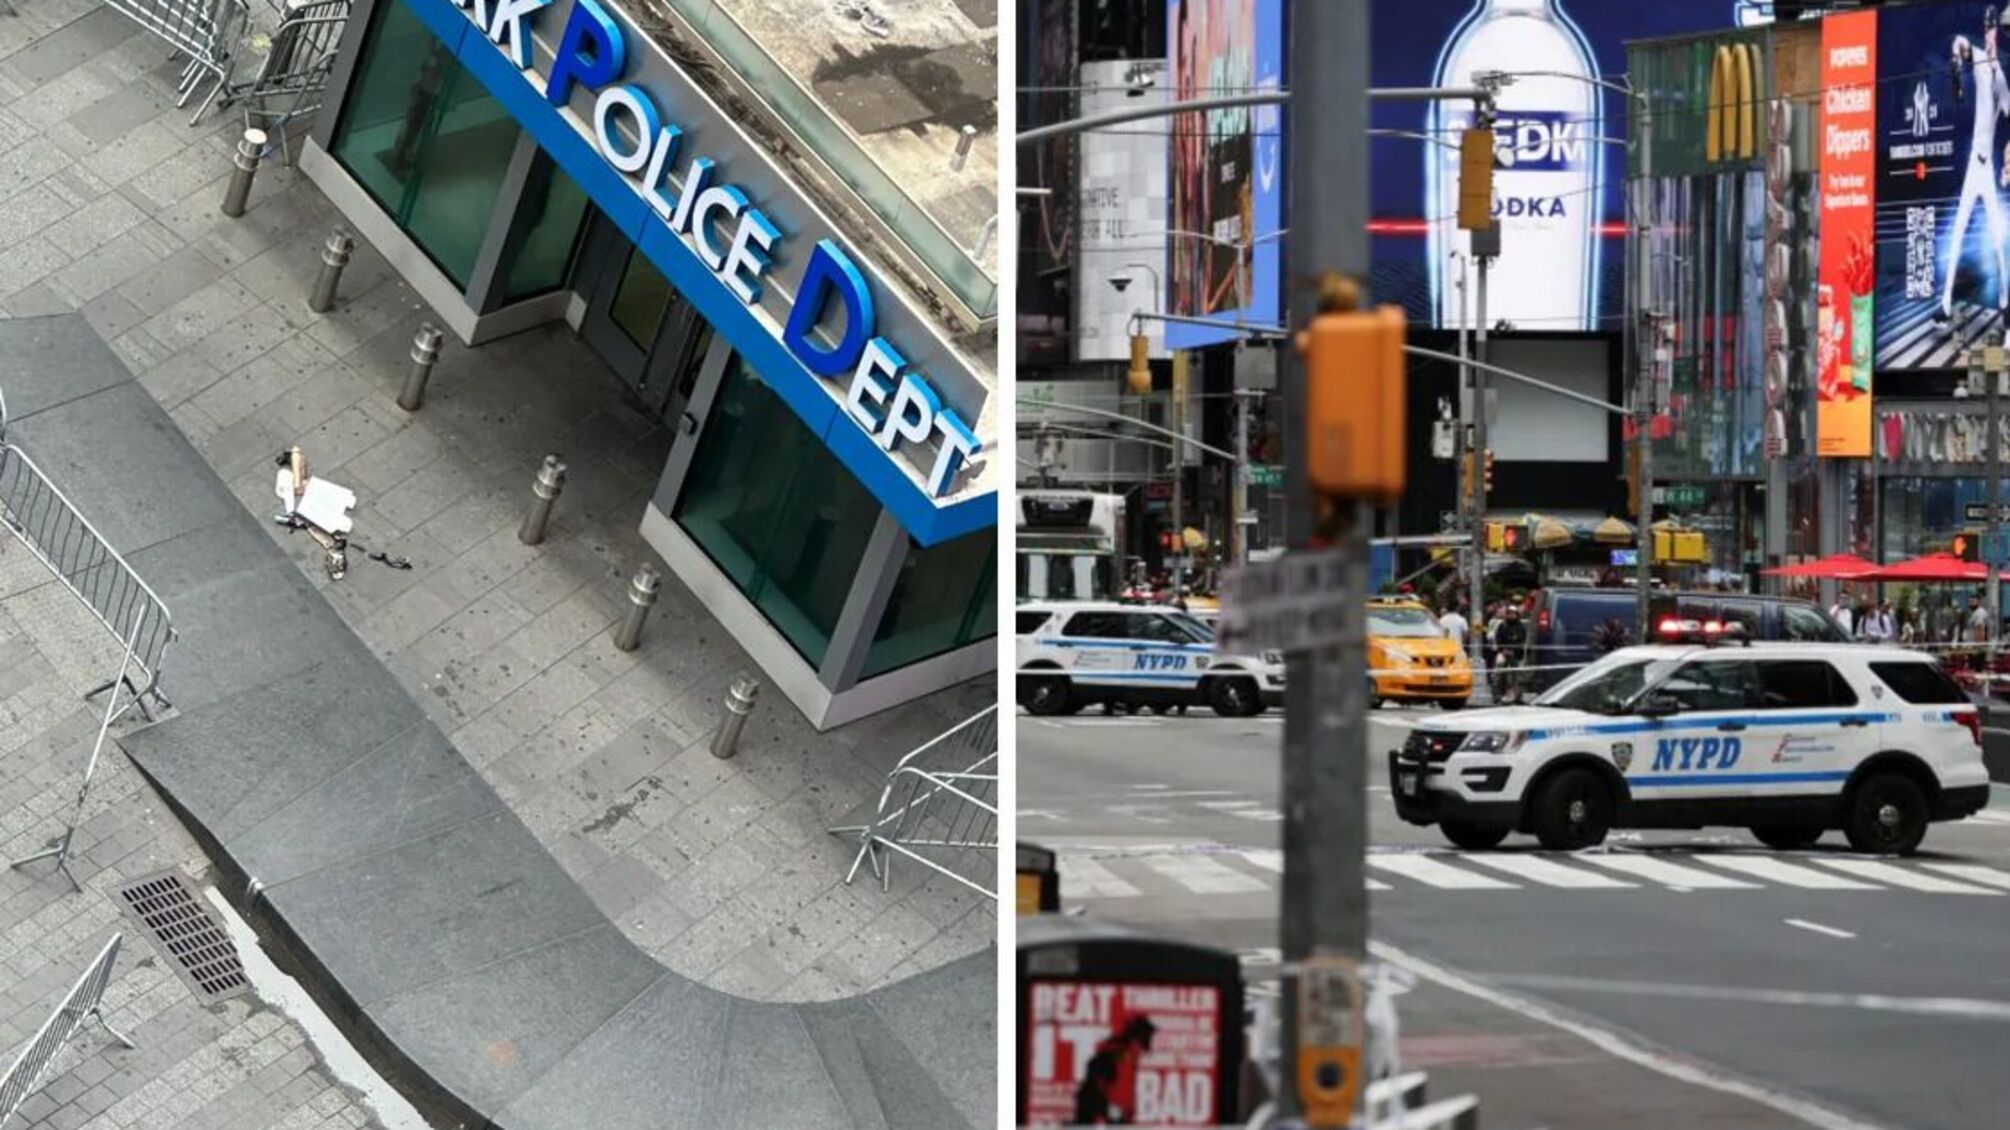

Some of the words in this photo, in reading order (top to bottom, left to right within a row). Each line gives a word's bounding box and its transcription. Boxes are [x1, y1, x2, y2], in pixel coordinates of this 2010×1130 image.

[1826, 85, 1871, 115] Chicken
[1825, 124, 1870, 160] Dippers
[1490, 197, 1566, 217] ODKA
[546, 0, 782, 304] POLICE
[782, 238, 982, 499] DEPT
[1133, 653, 1187, 670] NYPD
[1652, 737, 1741, 771] NYPD
[1032, 984, 1112, 1022] BEAT
[1033, 1025, 1113, 1080] IT
[1135, 1070, 1213, 1122] BAD
